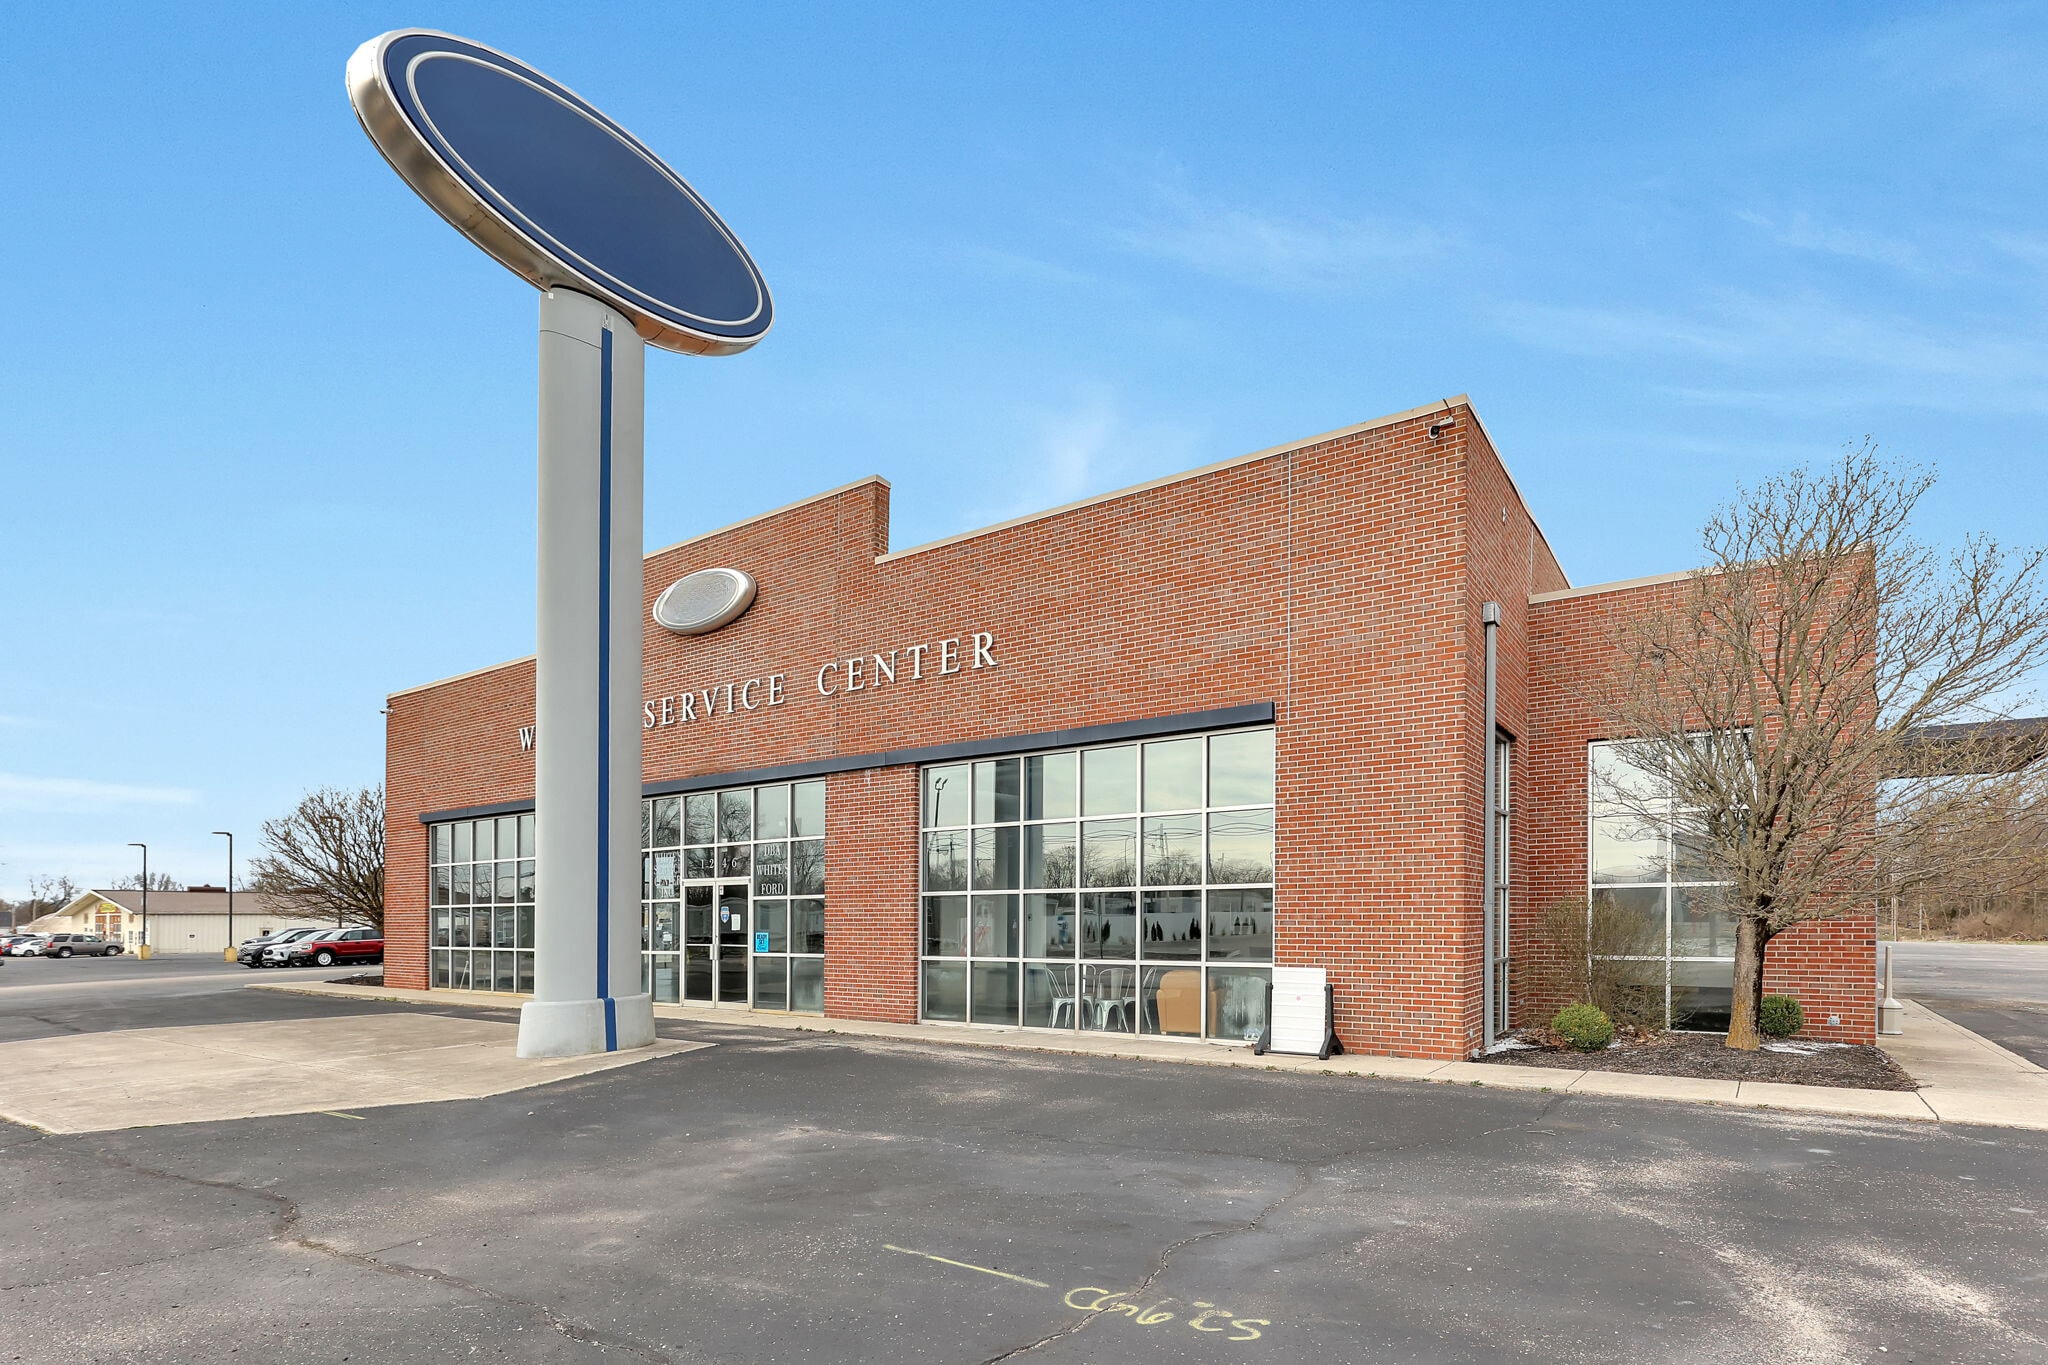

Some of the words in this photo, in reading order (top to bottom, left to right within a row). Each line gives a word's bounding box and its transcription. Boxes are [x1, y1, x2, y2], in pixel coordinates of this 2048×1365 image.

[643, 674, 785, 728] SERVICE
[817, 631, 998, 697] CENTER
[764, 845, 781, 857] DBA
[756, 863, 788, 876] WHITE'S
[761, 883, 784, 895] FORD
